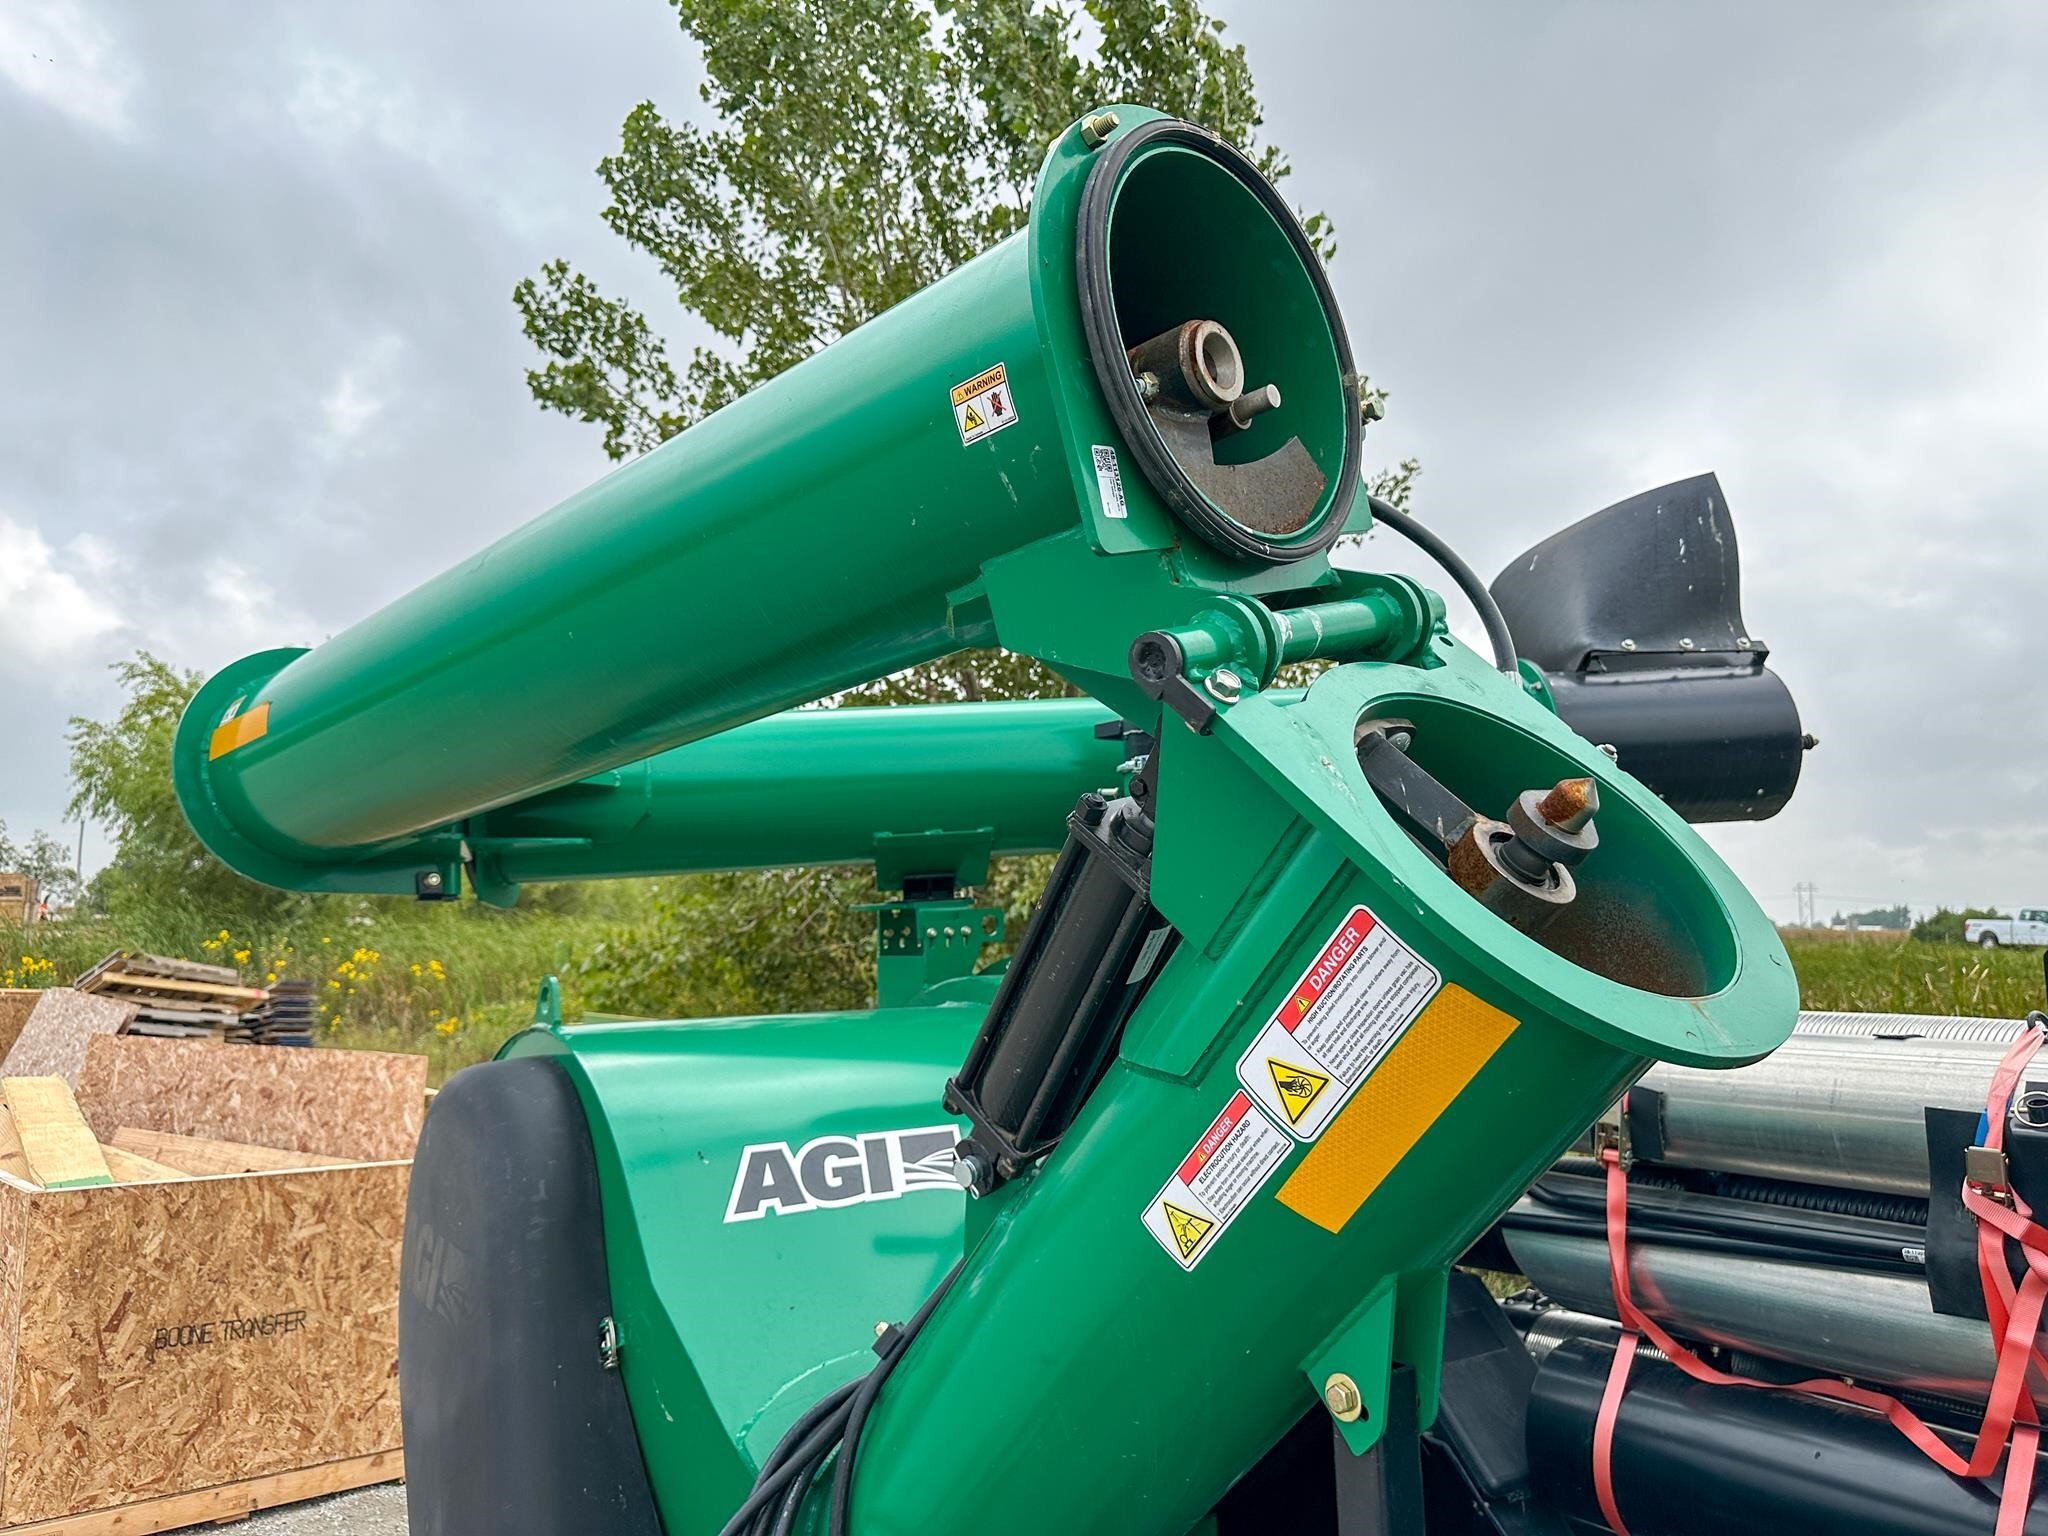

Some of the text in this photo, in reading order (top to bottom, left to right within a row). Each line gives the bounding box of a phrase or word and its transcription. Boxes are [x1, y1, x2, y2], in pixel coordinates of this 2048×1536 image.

[964, 370, 1002, 397] WARNING
[1307, 946, 1369, 1024] HIGH SUCTION/ROTATING PARTS
[1308, 926, 1361, 991] DANGER
[1199, 1141, 1234, 1184] ELECTROCUTION
[1231, 1119, 1251, 1143] HAZARD
[1202, 1116, 1233, 1155] DANGER
[723, 1130, 902, 1223] AGI
[155, 1310, 307, 1349] BOONE TRANSFER
